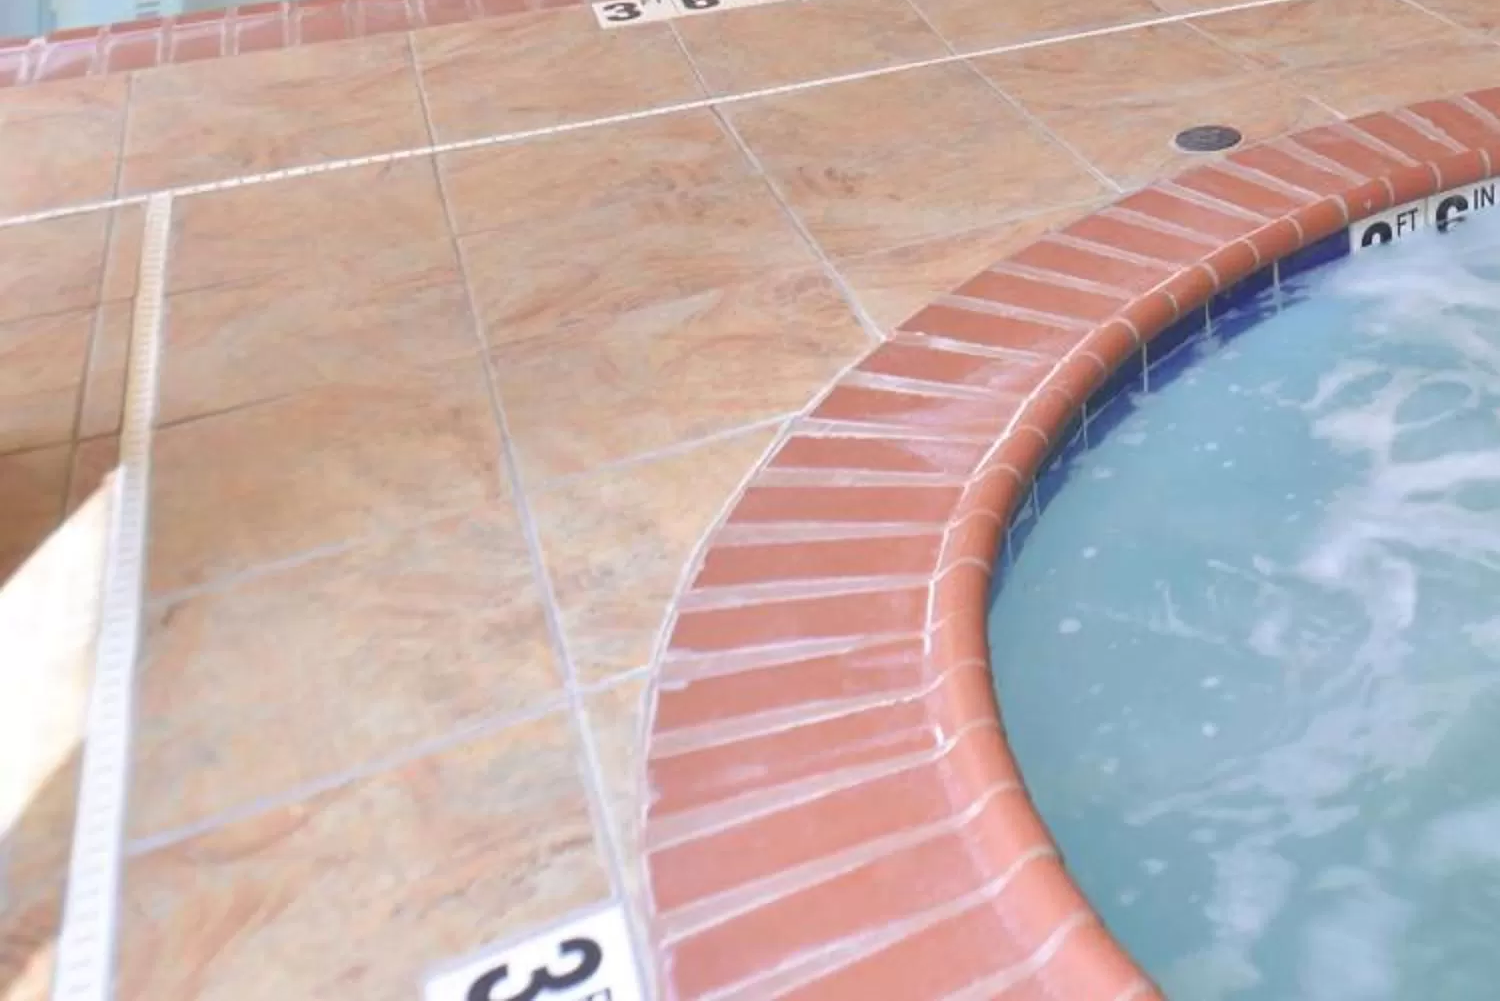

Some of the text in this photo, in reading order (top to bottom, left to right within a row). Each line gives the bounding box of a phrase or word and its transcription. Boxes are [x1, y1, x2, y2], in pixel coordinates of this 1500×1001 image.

[603, 2, 642, 21] 3
[1397, 208, 1418, 238] FT
[1474, 183, 1495, 210] IN
[467, 937, 603, 1001] 3
